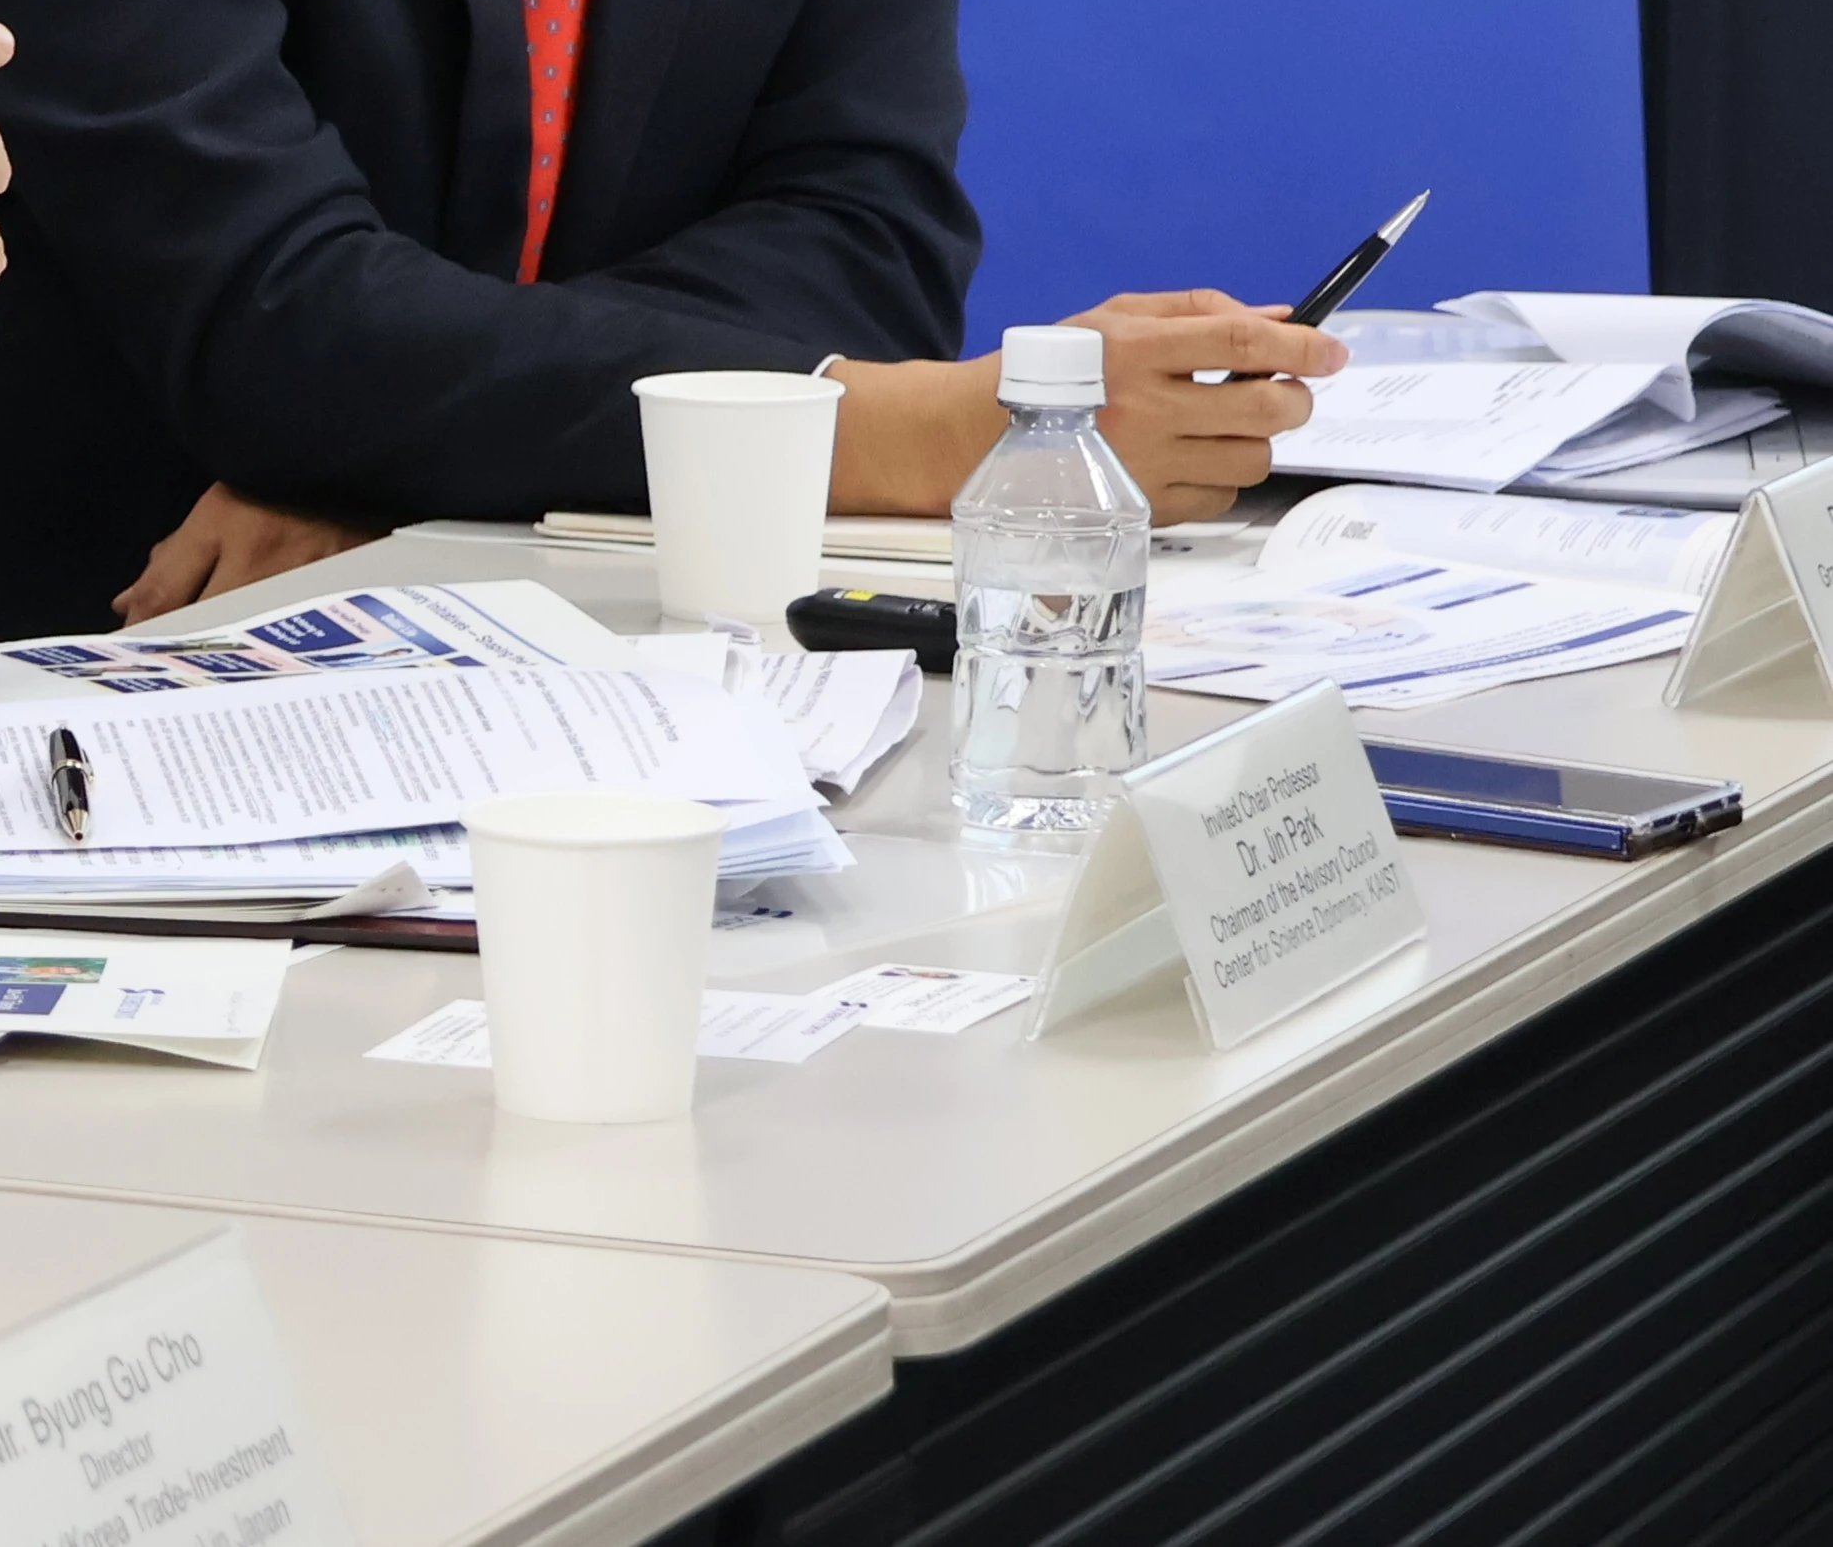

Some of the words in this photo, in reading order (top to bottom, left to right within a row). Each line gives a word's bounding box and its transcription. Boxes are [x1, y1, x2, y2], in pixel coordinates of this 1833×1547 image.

[1201, 796, 1243, 838] Invited
[1238, 784, 1271, 819] Chair
[1267, 761, 1321, 804] Professor
[1236, 839, 1267, 877] Dr.
[1263, 826, 1291, 865] Jin
[1283, 806, 1325, 854] Park
[1210, 897, 1270, 944] Chairman
[1266, 883, 1280, 915] of
[1278, 879, 1300, 908] the
[1295, 857, 1344, 899] Advisory
[1338, 830, 1380, 873] Council
[1214, 951, 1256, 989] Center
[1251, 940, 1271, 972] for
[1268, 919, 1317, 958] Science
[1365, 863, 1401, 903] KAIST
[22, 1397, 112, 1449] Byung
[106, 1355, 151, 1402] Gu
[146, 1332, 203, 1383] Cho
[79, 1432, 154, 1489] Director
[125, 1425, 293, 1532] Trade-Investment
